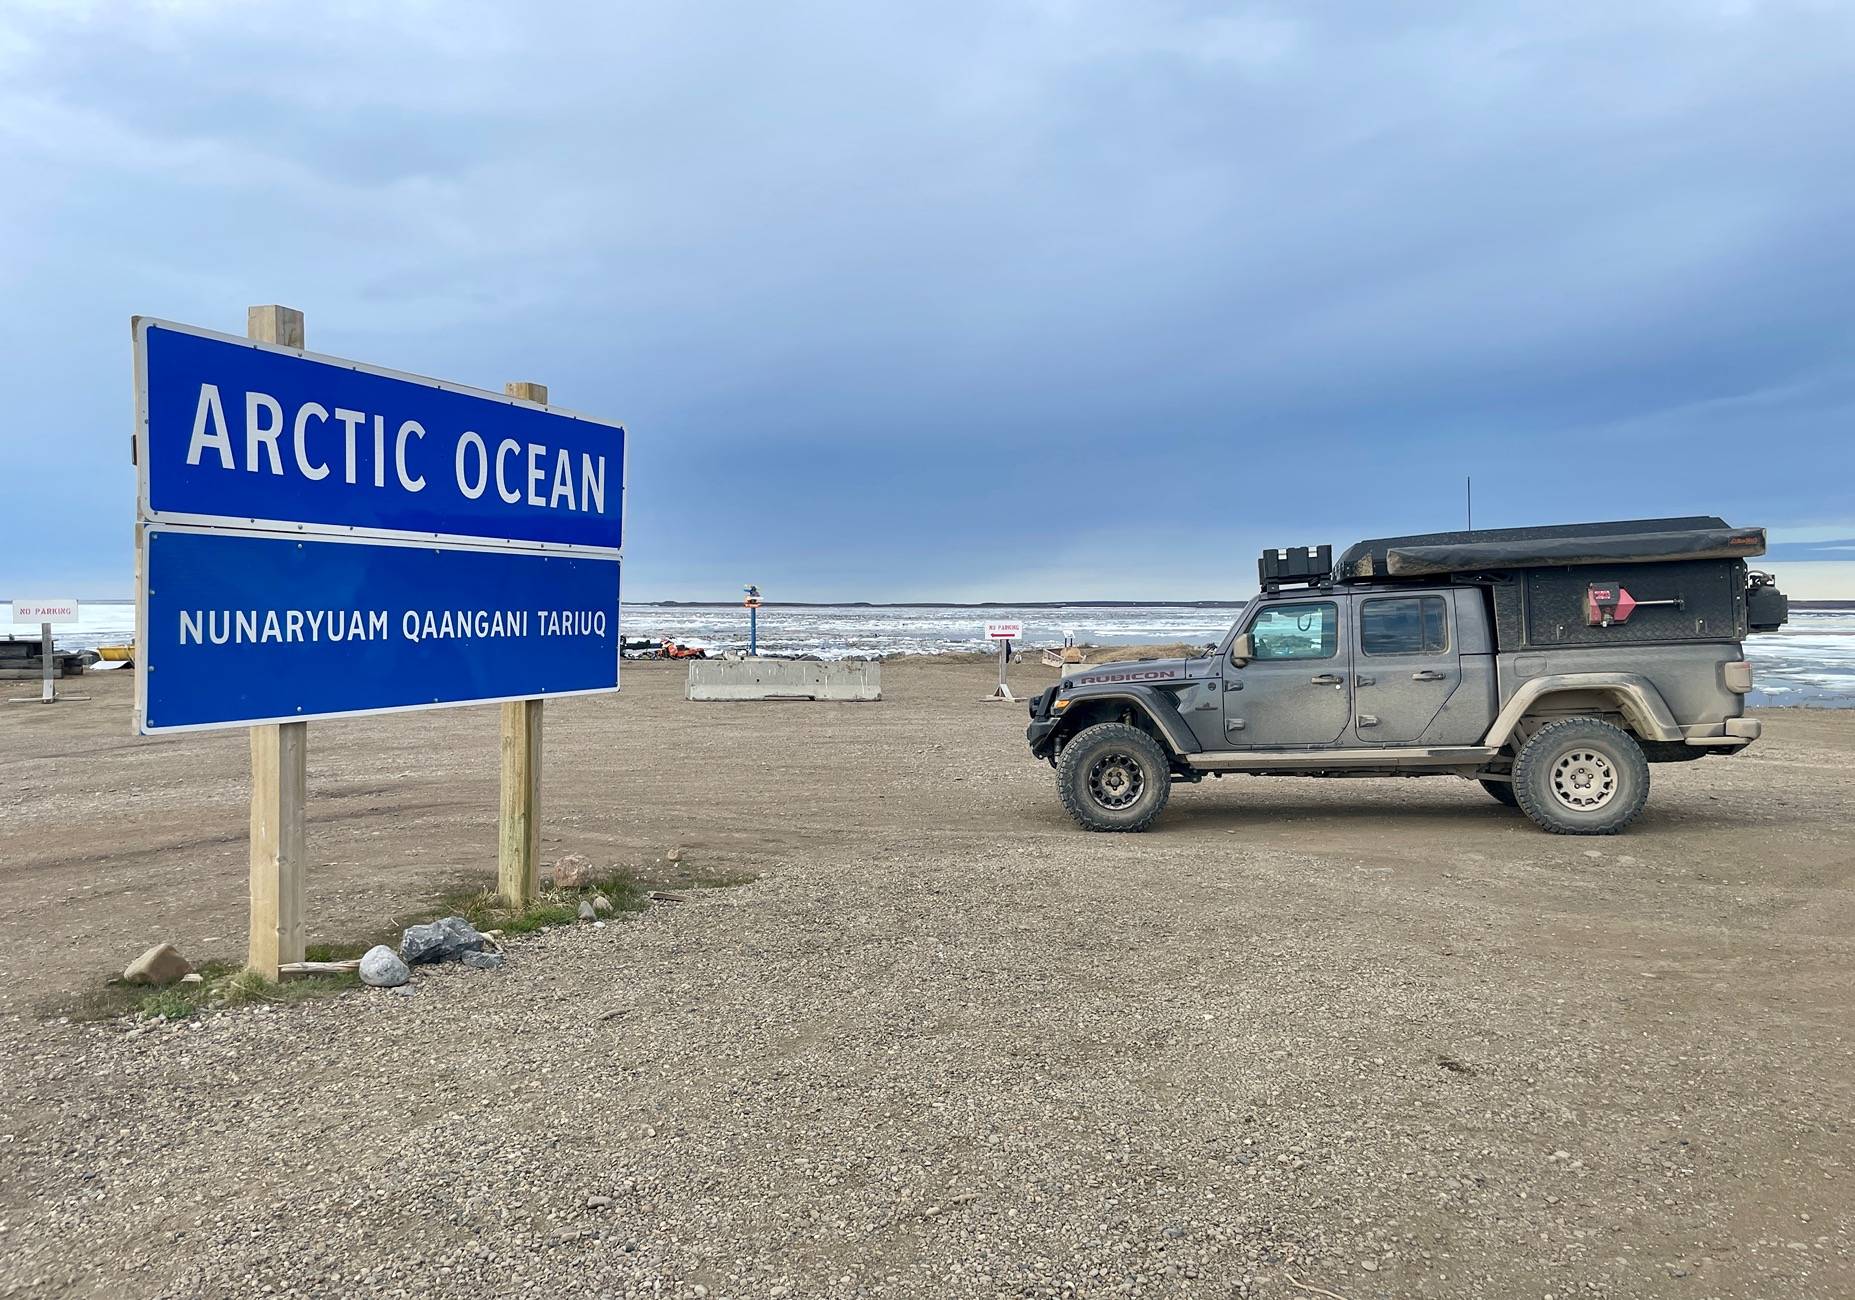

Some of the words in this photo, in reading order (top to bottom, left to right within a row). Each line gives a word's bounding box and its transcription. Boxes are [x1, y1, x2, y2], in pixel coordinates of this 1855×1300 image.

[186, 383, 427, 493] ARCTIC
[455, 431, 606, 514] OCEAN
[20, 607, 30, 615] NO
[35, 607, 71, 615] PARKING
[179, 610, 389, 645] NUNARYUAM
[402, 610, 528, 643] QAANGANI
[538, 611, 606, 638] TARIUQ
[1081, 671, 1175, 684] RUBICON
